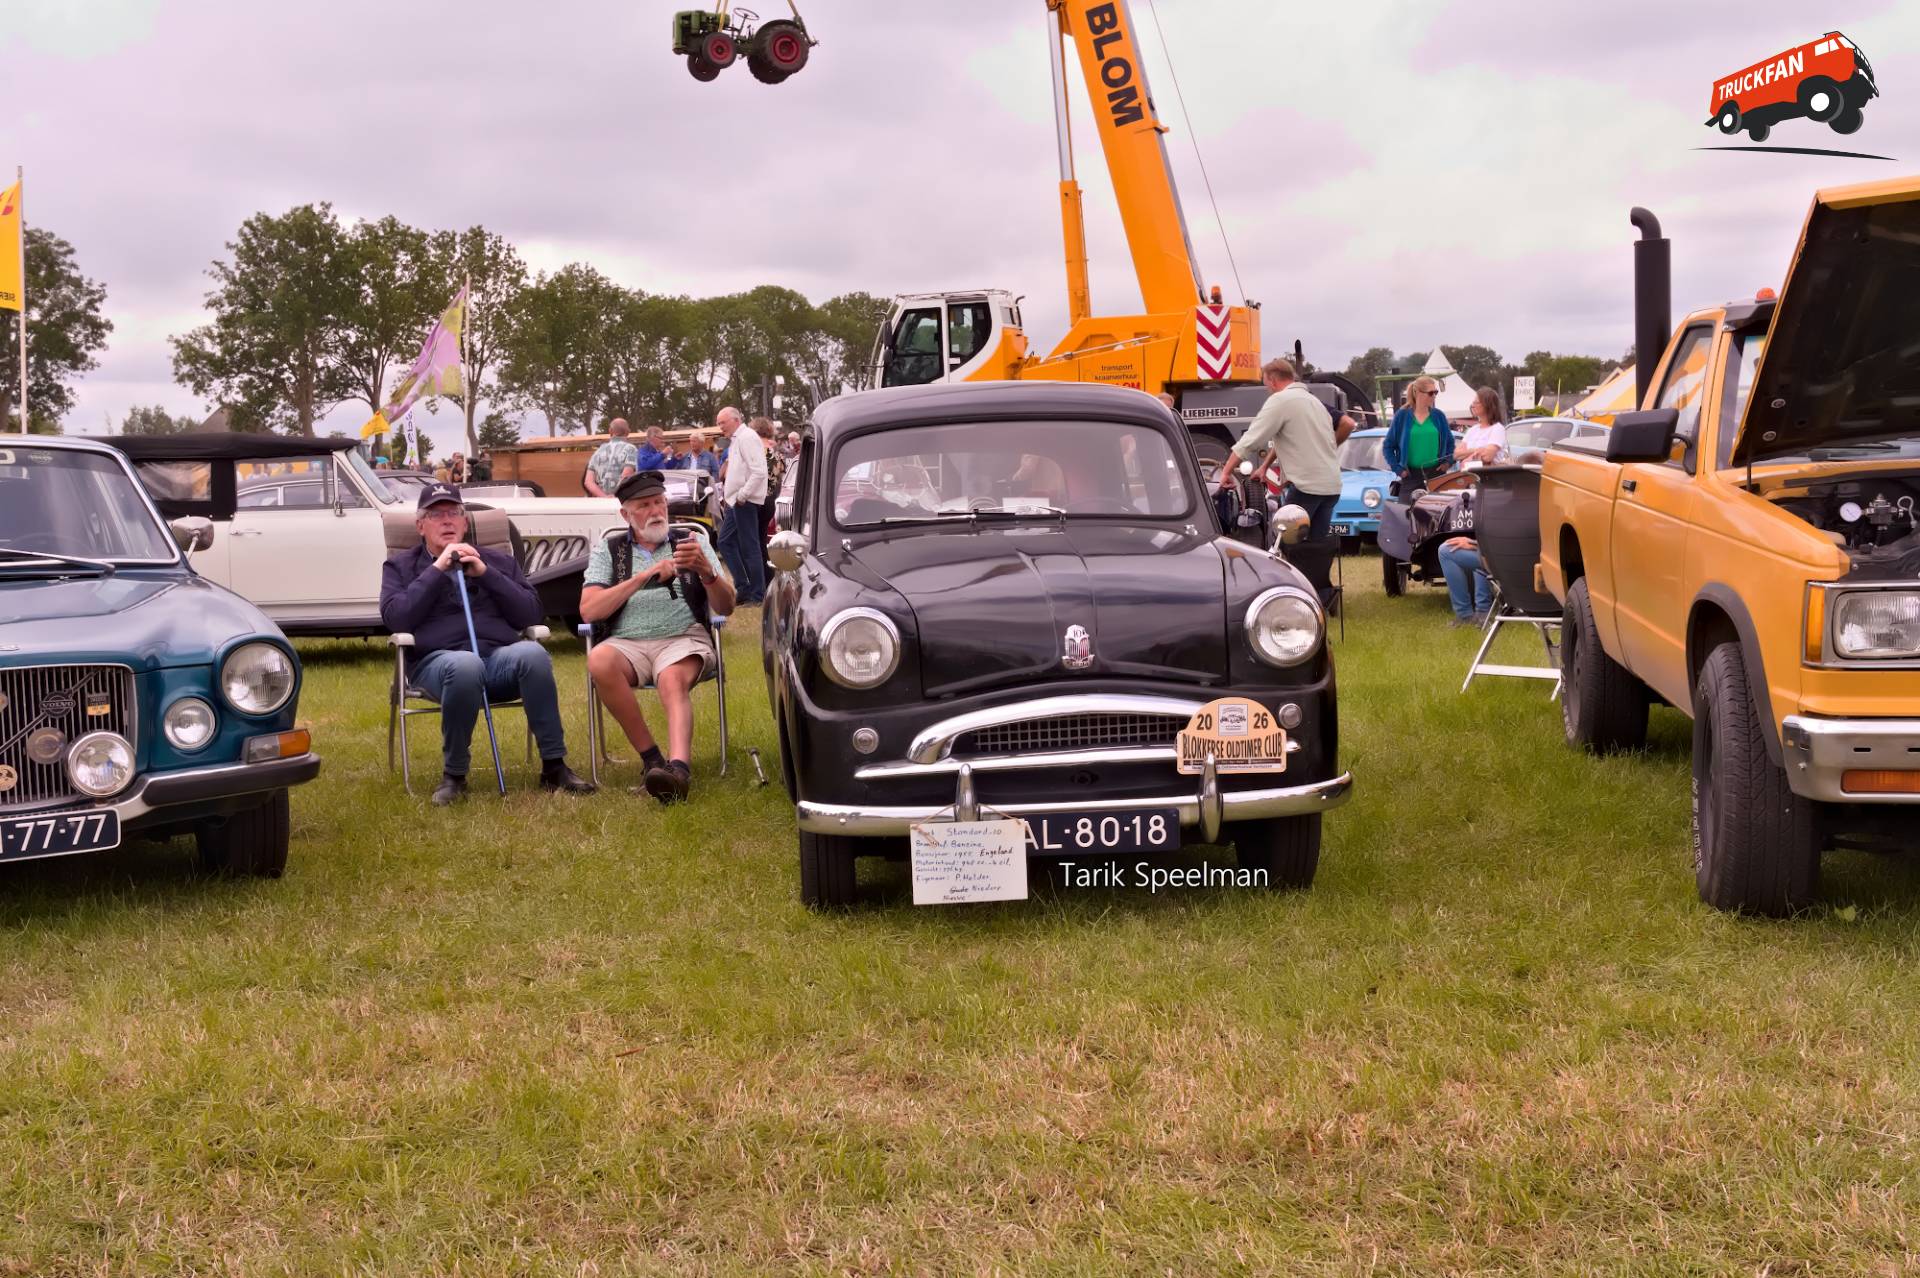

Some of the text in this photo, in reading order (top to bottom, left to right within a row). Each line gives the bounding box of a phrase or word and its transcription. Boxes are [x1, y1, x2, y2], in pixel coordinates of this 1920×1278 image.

[1085, 2, 1144, 128] BLOM
[1101, 363, 1133, 373] transport
[1183, 407, 1237, 418] LIEBHERR
[1457, 510, 1473, 518] AM
[42, 700, 75, 708] VOLVO
[1197, 714, 1212, 730] 20
[1254, 713, 1268, 729] 26
[1226, 738, 1262, 758] OLDTIMER
[1264, 732, 1282, 757] CLUB
